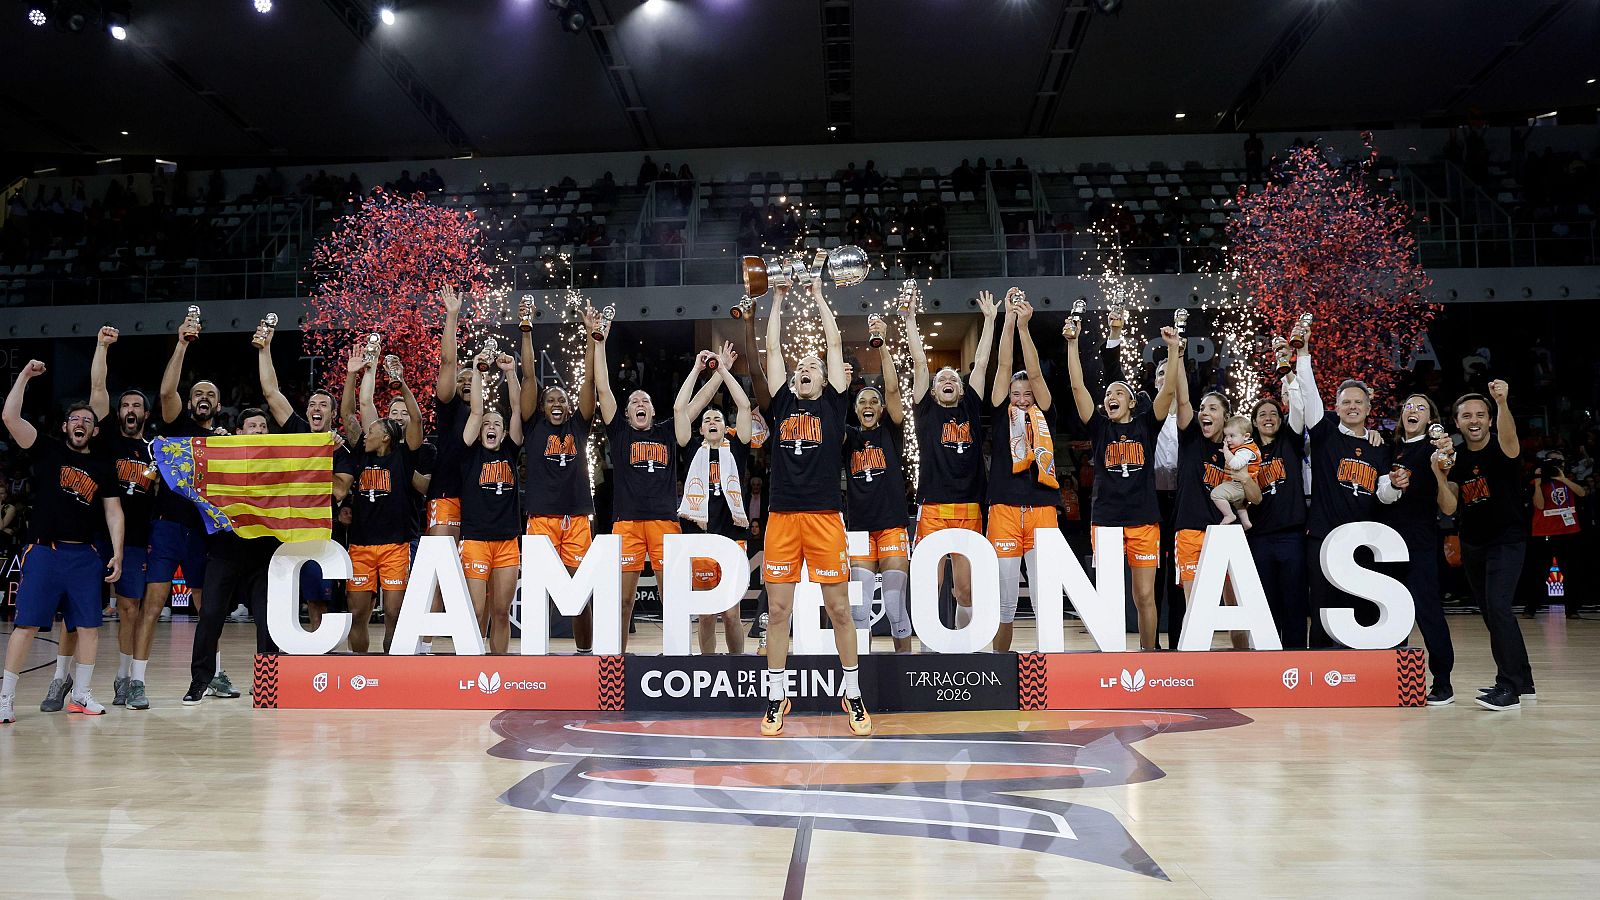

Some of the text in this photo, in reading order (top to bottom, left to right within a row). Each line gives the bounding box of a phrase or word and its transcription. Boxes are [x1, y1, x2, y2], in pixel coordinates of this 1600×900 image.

[738, 671, 756, 682] DE
[906, 671, 1002, 686] TARRAGONA
[1100, 676, 1194, 687] LF endesa
[459, 680, 546, 689] LF endesa
[640, 669, 735, 698] COPA
[738, 685, 757, 697] LA
[936, 688, 971, 701] 2026
